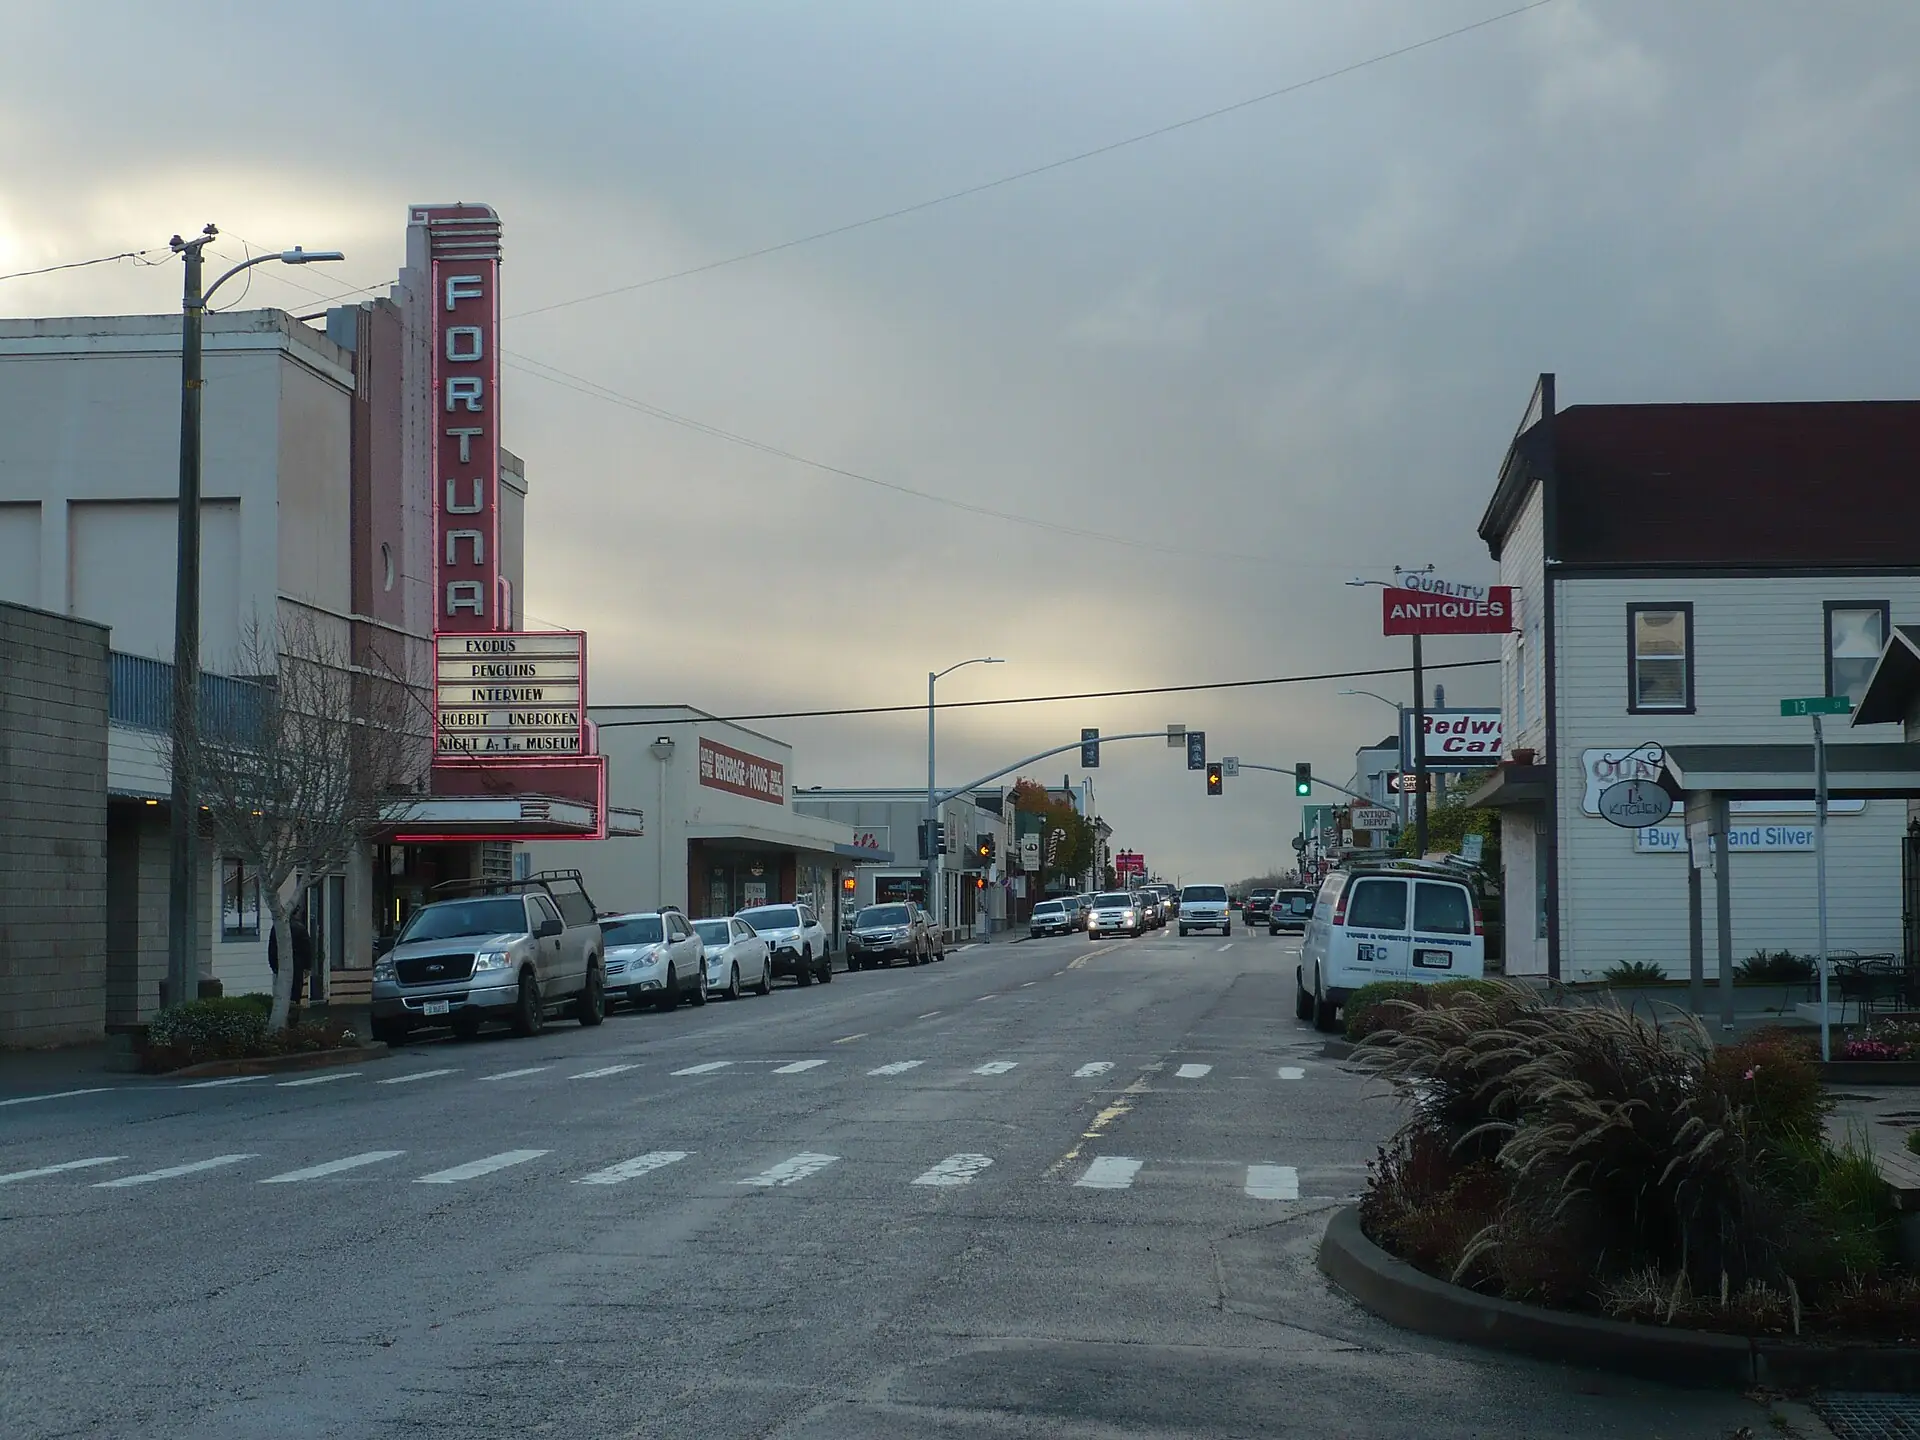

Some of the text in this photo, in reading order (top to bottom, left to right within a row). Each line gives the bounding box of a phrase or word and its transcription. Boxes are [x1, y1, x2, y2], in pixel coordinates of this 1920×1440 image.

[445, 273, 484, 617] FORTUNA
[1405, 575, 1484, 600] QUALITY
[1390, 602, 1505, 619] ANTIQUES
[466, 640, 516, 652] EXODUS
[472, 664, 536, 676] PENGUINS
[472, 688, 544, 701] INTERVIEW
[1793, 701, 1806, 713] 13
[442, 712, 578, 725] HOBBIT UNBROKEN
[439, 738, 479, 750] NIGHT
[526, 738, 580, 750] MUSEUM
[715, 753, 746, 786] BEVERAGE
[749, 764, 768, 793] FOODS
[1609, 803, 1662, 816] KITCHEN
[1649, 828, 1680, 849] Buy
[1729, 828, 1760, 845] and
[1765, 827, 1813, 845] Silver
